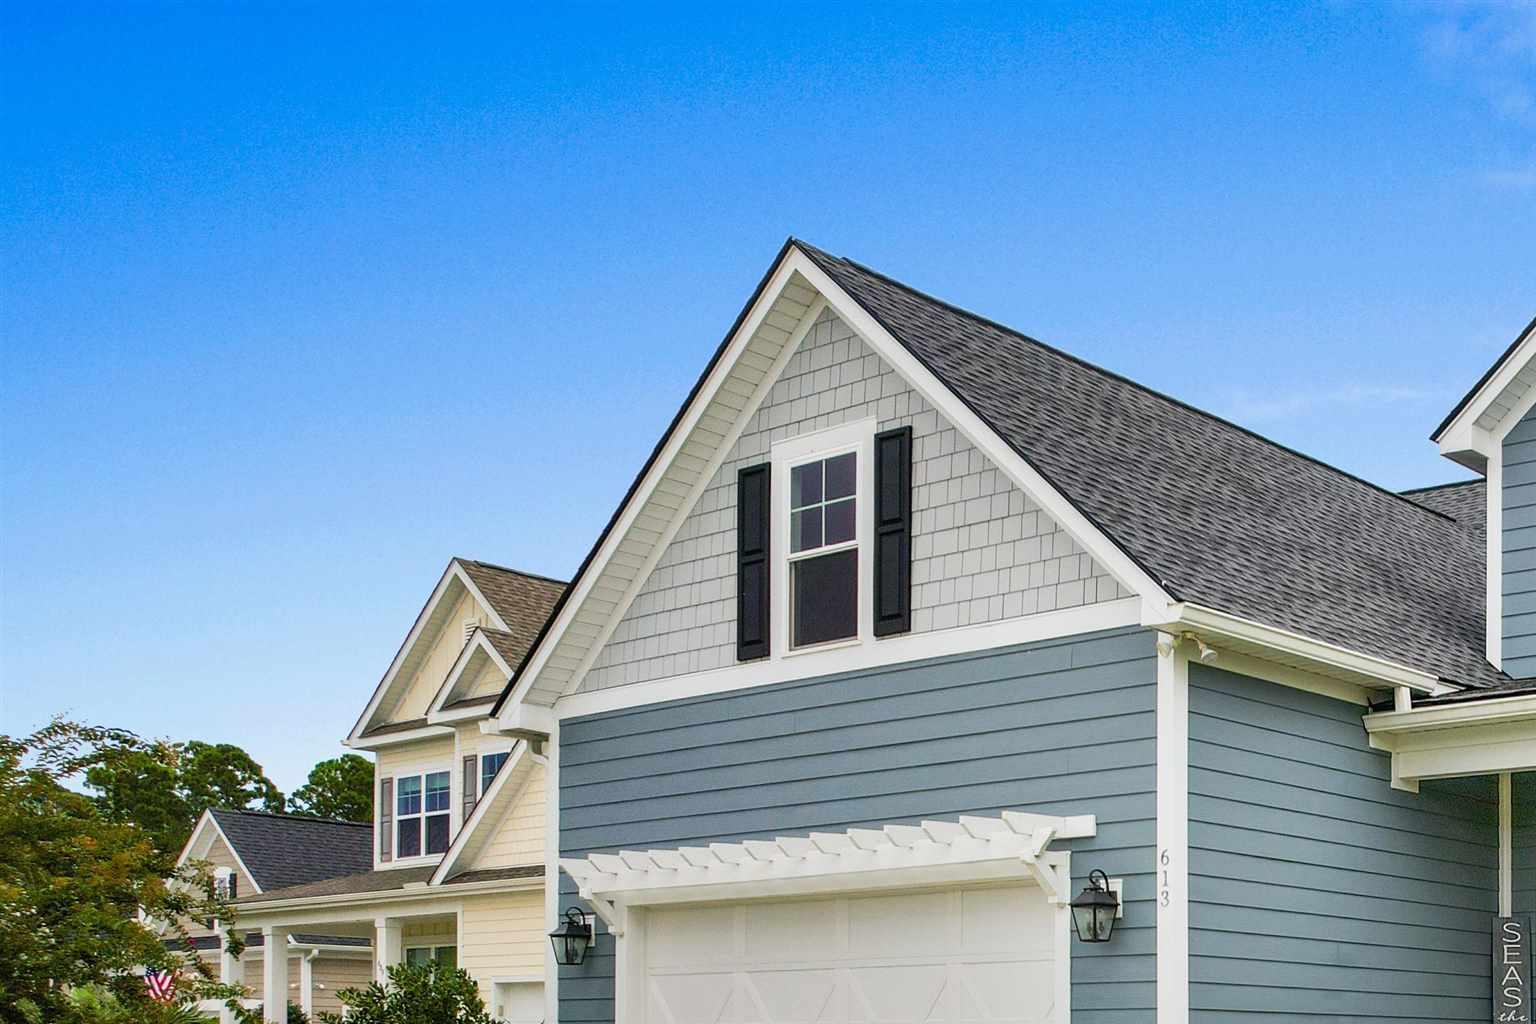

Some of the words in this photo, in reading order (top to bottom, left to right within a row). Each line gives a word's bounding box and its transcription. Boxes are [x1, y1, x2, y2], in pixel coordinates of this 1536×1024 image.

[1161, 848, 1170, 908] 613
[1502, 922, 1523, 1007] SEAS
[1497, 1010, 1529, 1022] the
